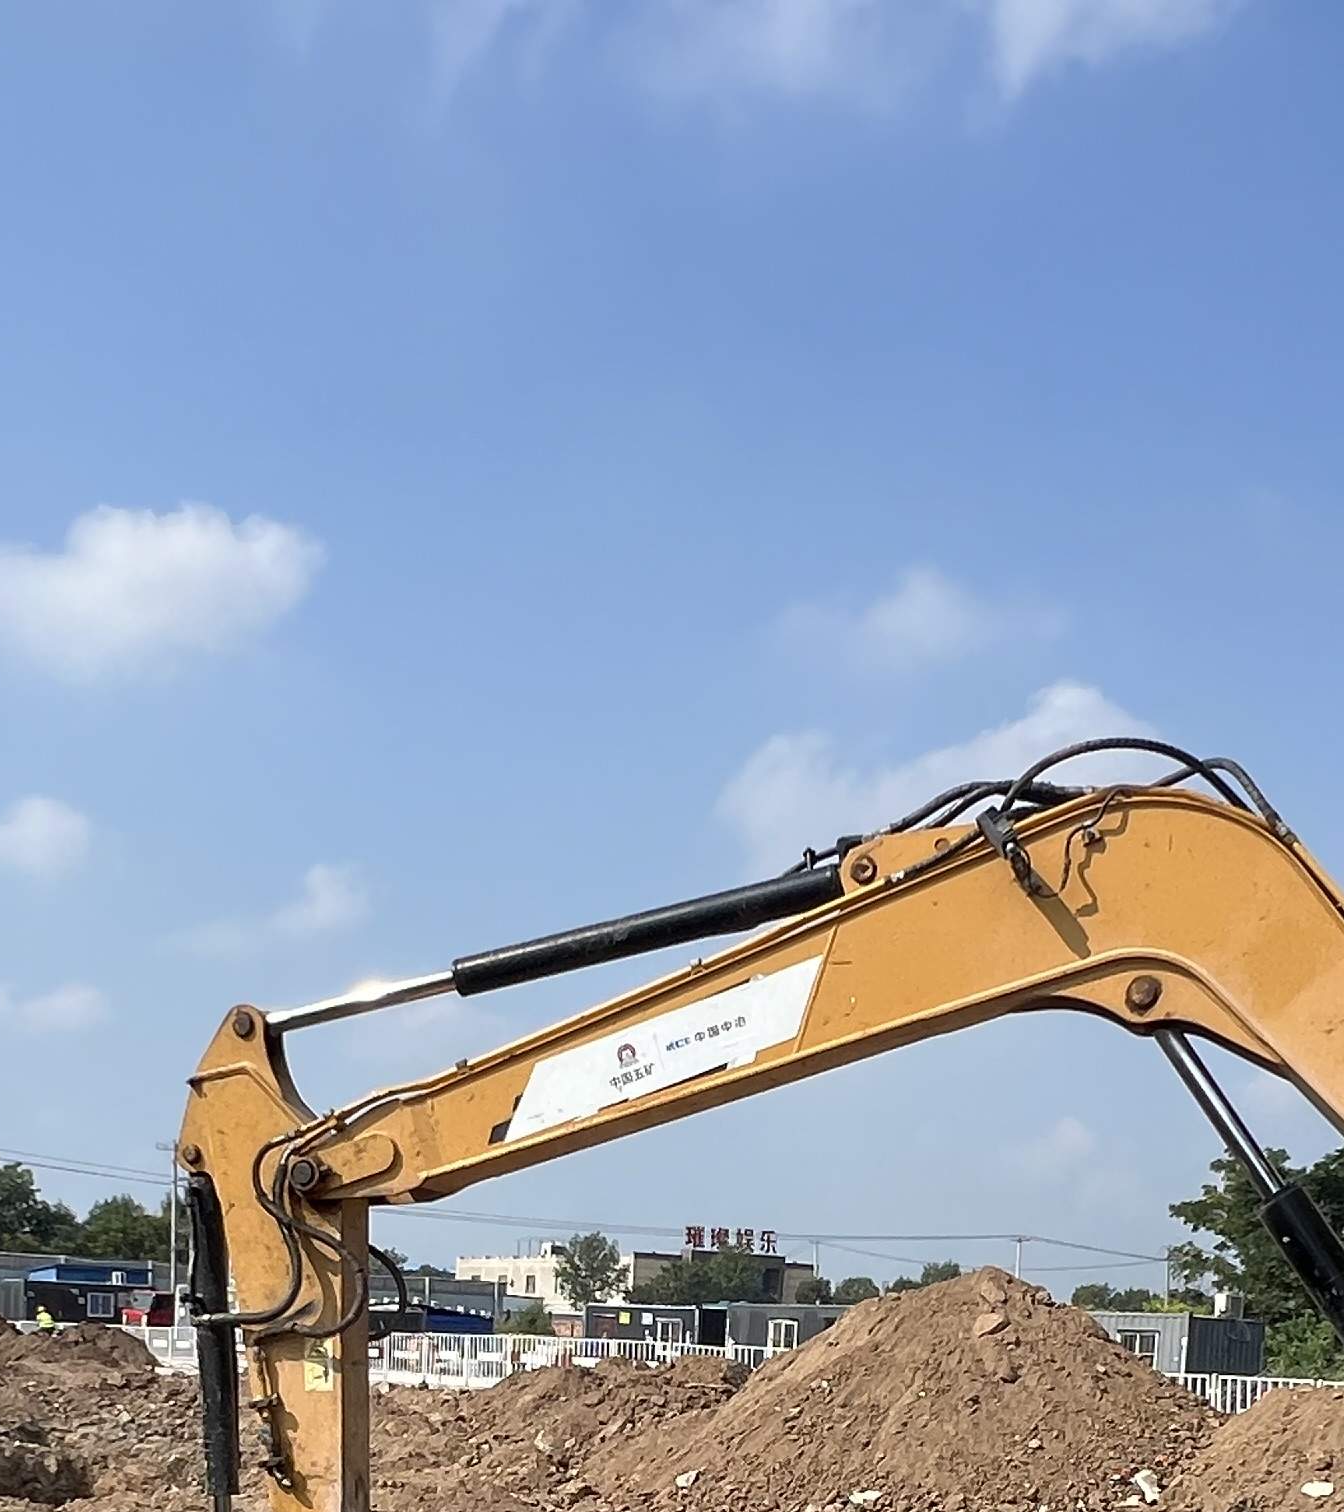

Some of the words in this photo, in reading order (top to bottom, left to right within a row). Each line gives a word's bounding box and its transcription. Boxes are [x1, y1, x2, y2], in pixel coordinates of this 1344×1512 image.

[609, 1063, 655, 1090] 中国五矿
[685, 1226, 777, 1254] 璀璨娱乐
